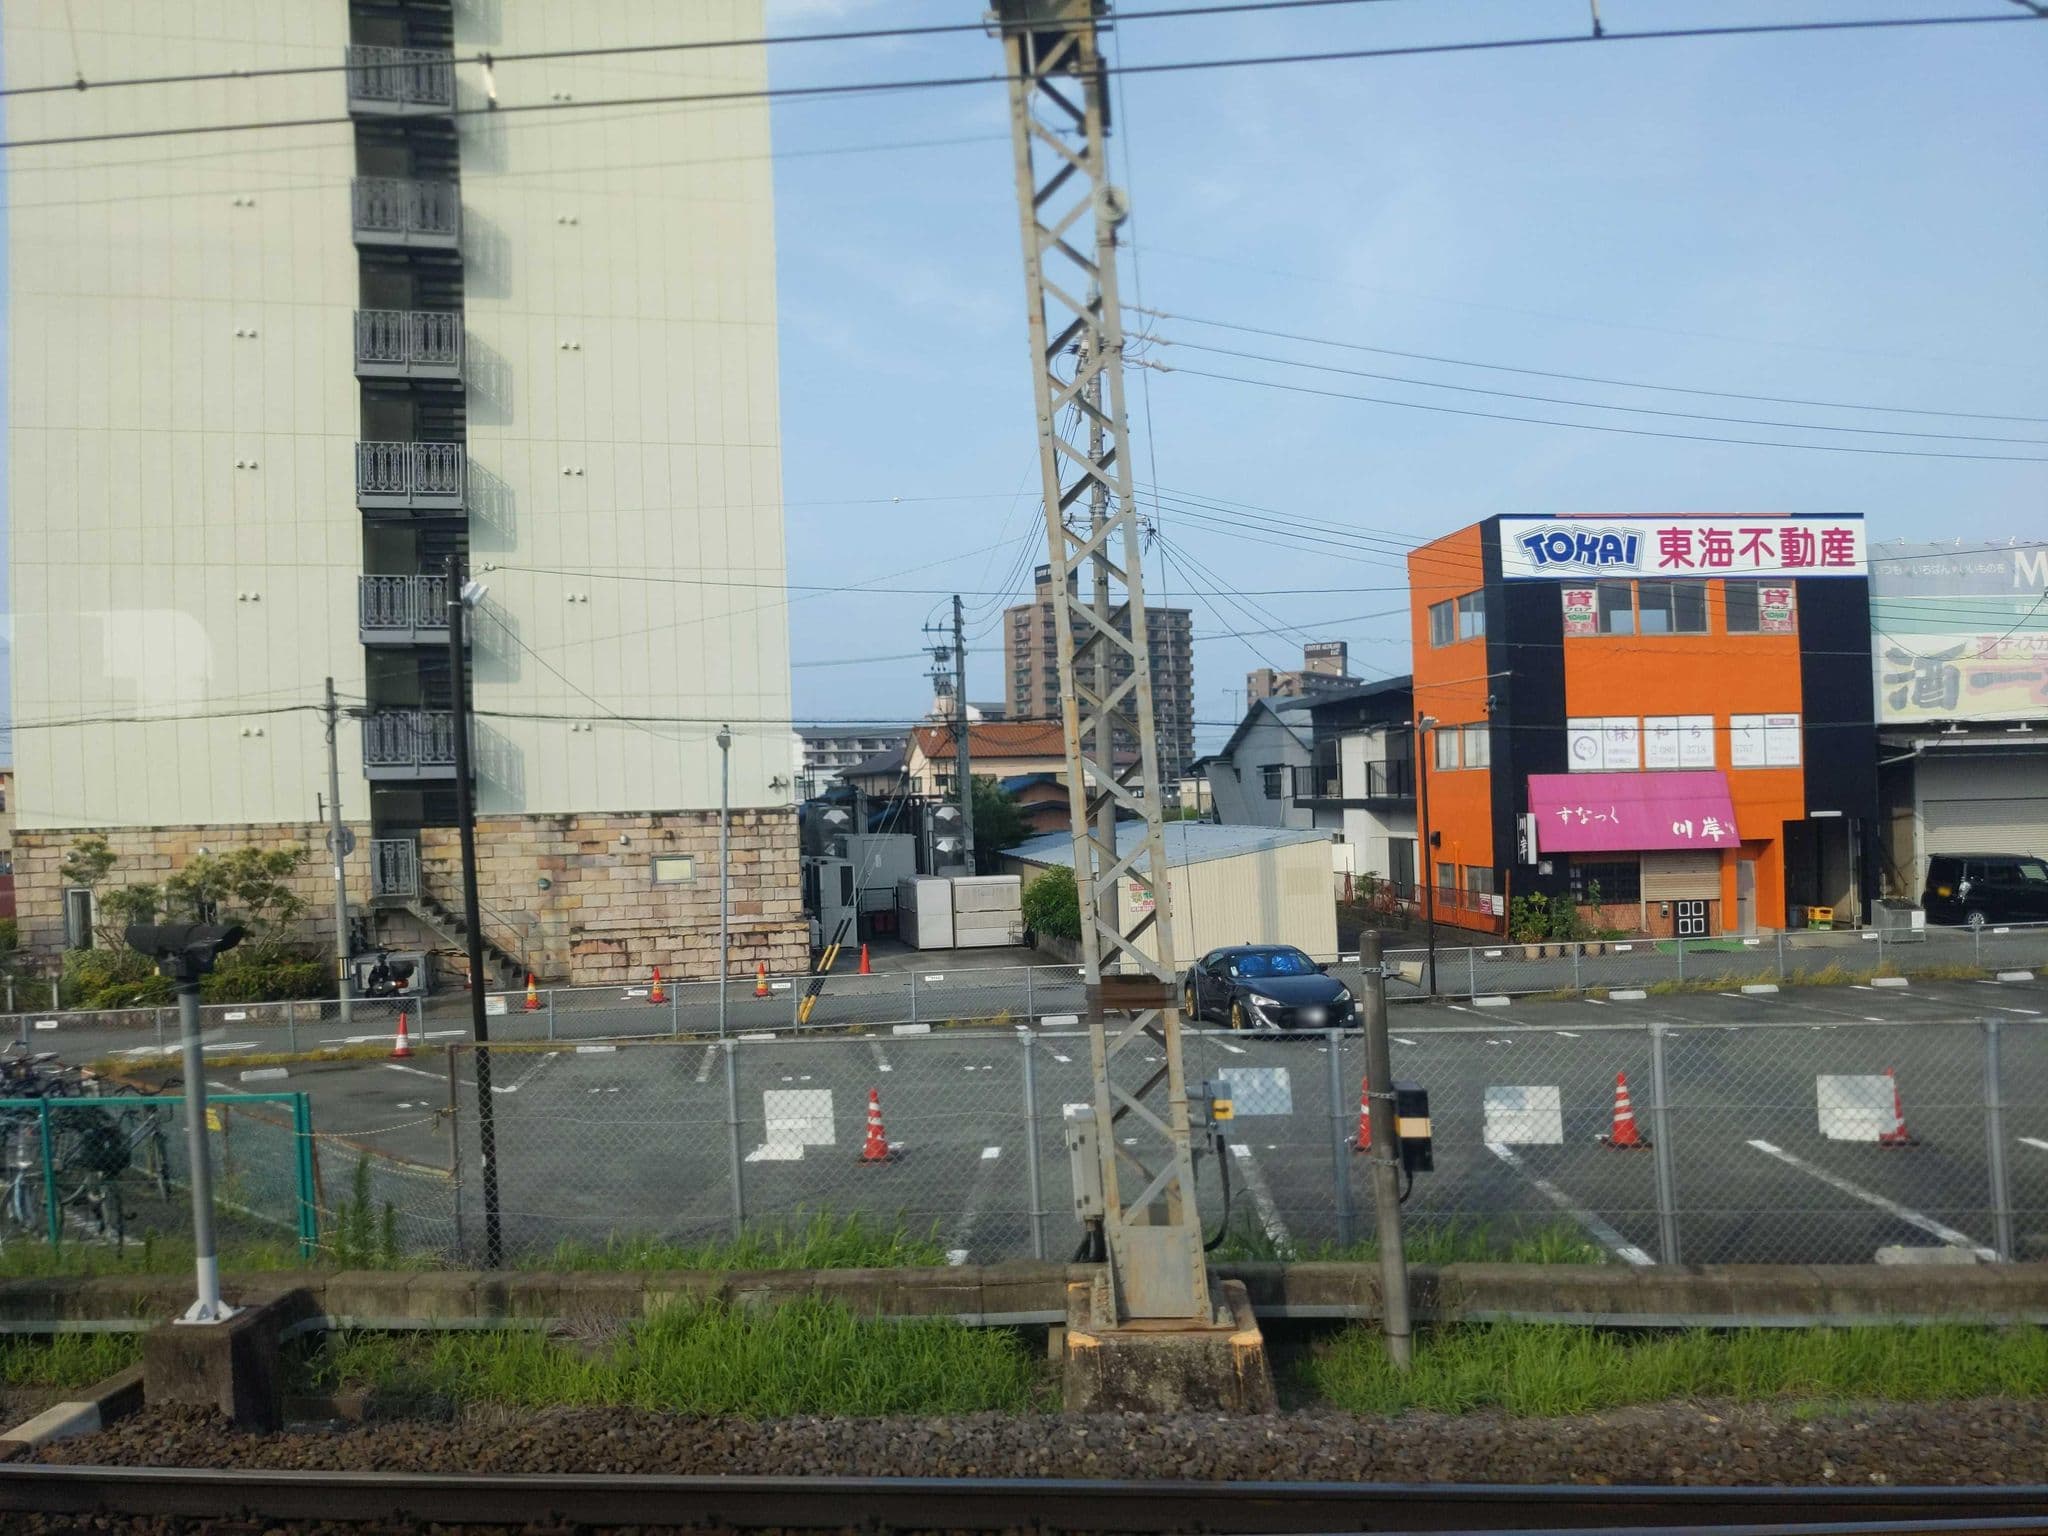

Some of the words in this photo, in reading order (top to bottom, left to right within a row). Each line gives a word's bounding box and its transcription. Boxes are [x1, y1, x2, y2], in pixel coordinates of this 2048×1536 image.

[1520, 529, 1639, 569] TOKAI
[1656, 526, 1856, 569] 東海不動産
[1565, 591, 1592, 607] 貸
[1556, 806, 1619, 825] すなっく
[1672, 816, 1725, 842] 川岸
